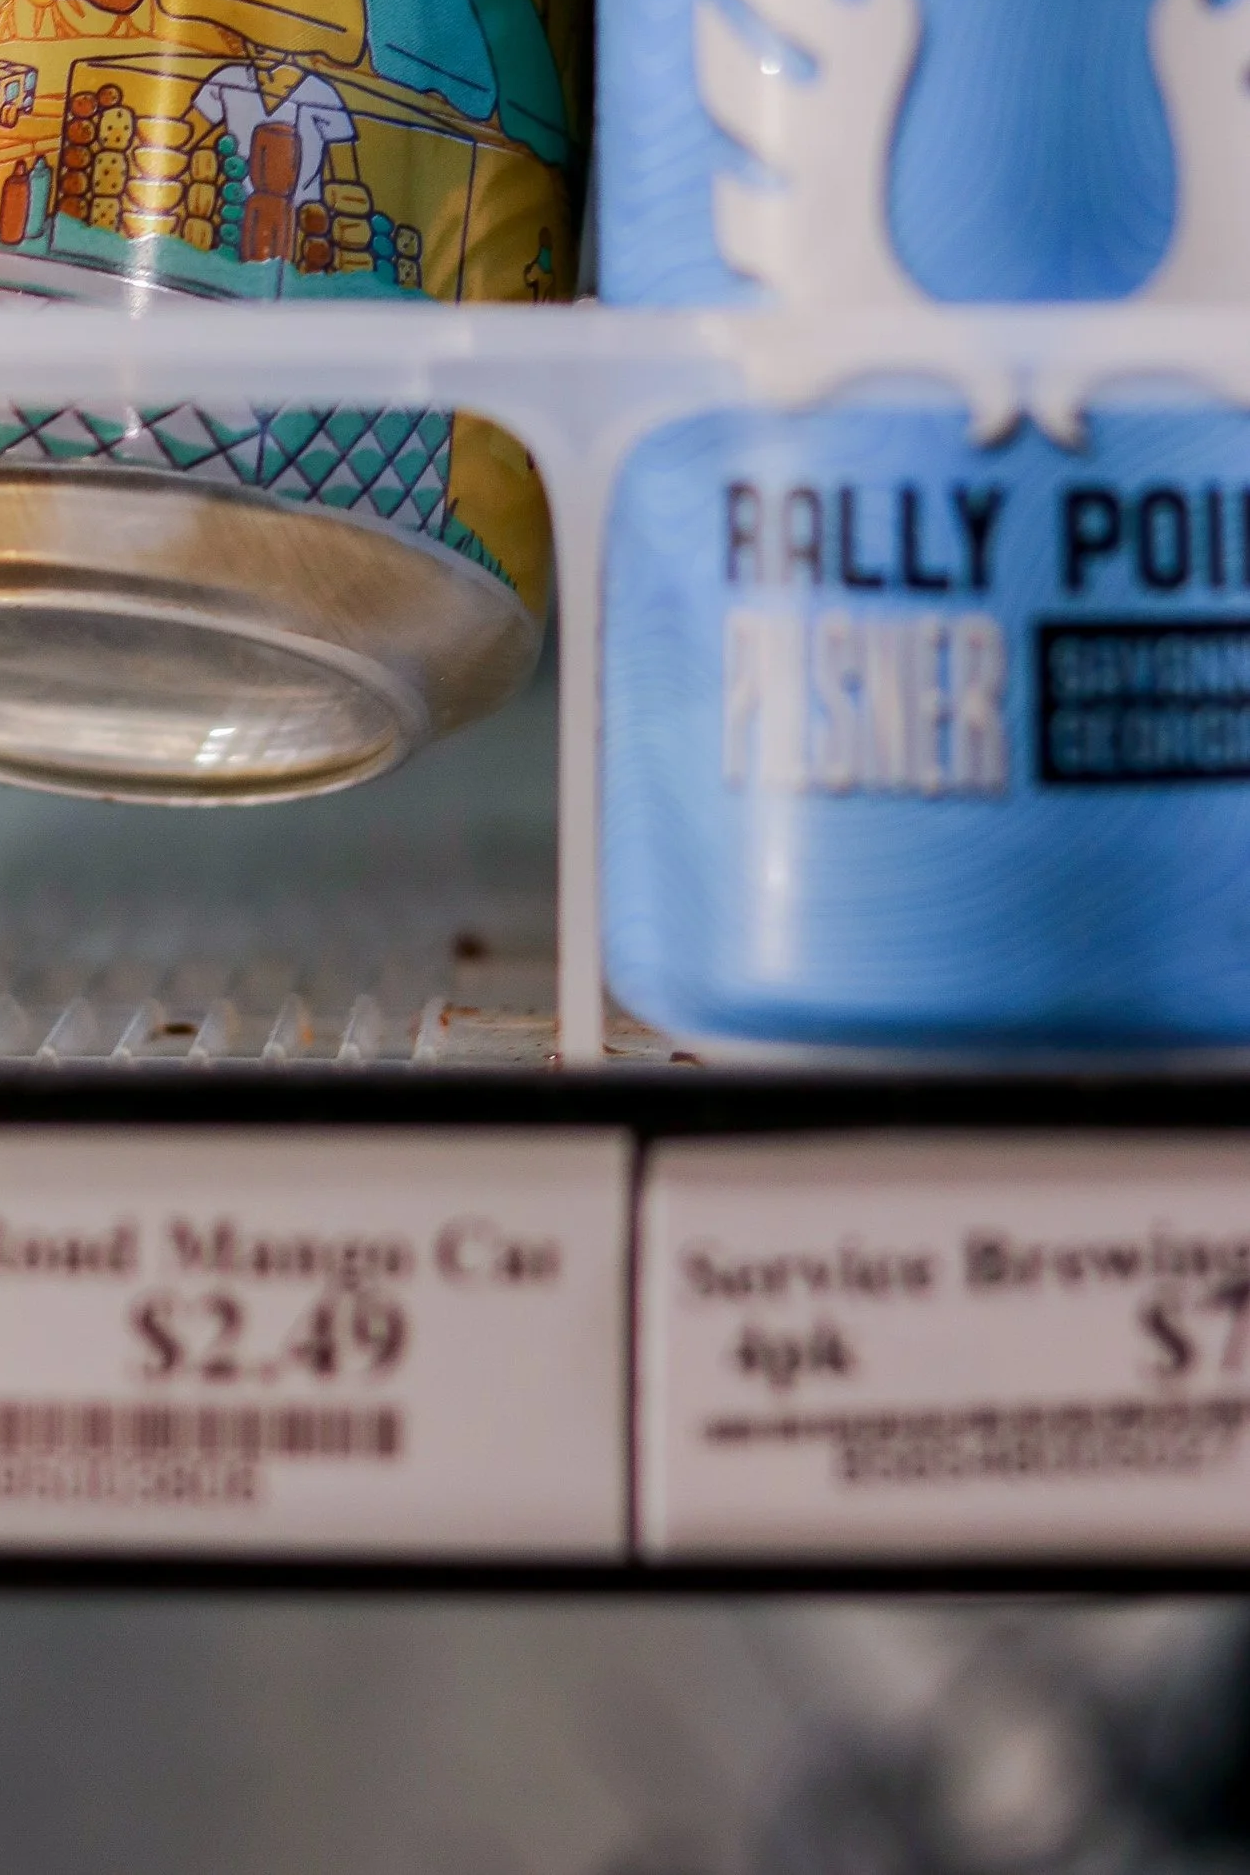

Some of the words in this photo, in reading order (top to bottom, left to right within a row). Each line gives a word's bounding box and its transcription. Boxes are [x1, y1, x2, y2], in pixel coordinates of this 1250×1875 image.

[723, 479, 1006, 593] RALLY
[168, 1217, 412, 1289] Mango
[128, 1291, 412, 1385] $2.49
